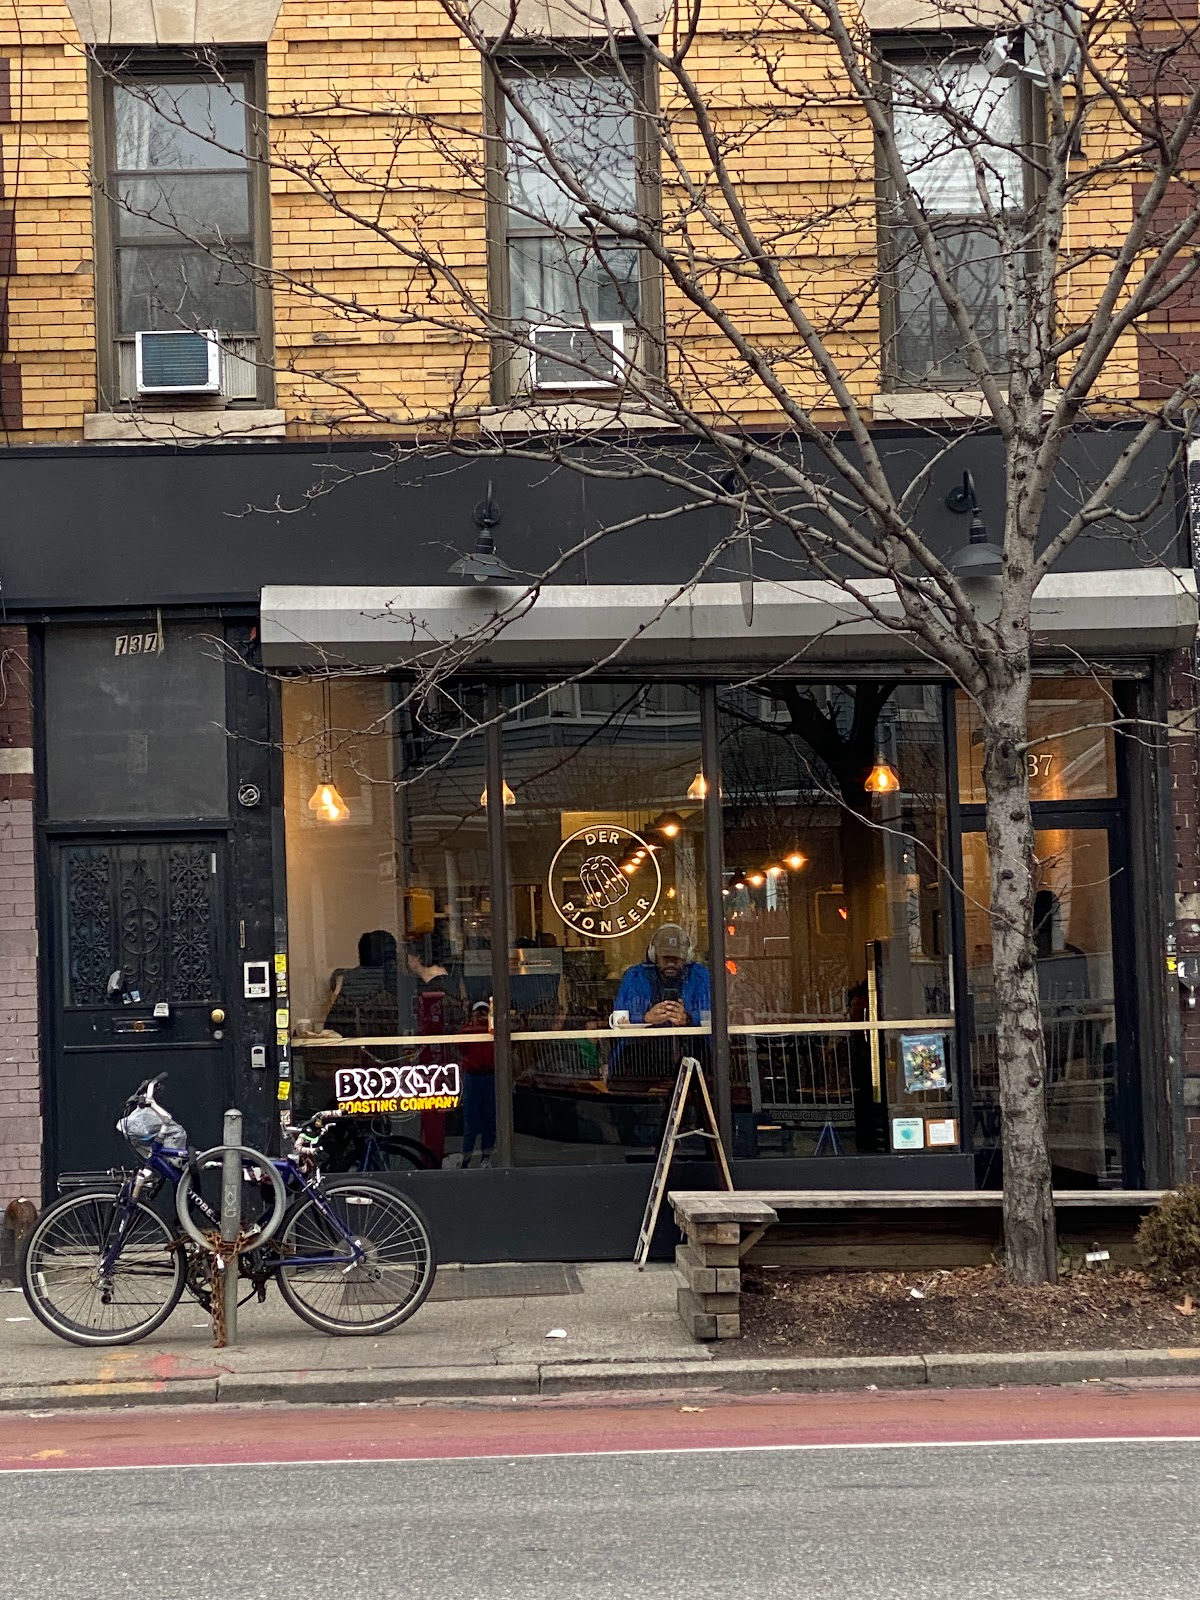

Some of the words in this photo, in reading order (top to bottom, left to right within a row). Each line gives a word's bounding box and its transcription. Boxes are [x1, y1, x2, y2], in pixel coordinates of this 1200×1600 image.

[116, 634, 157, 655] 737
[585, 831, 620, 846] DER
[562, 898, 650, 932] PIONEER
[335, 1063, 460, 1101] BROOKLYN
[400, 1096, 459, 1112] COMPANY
